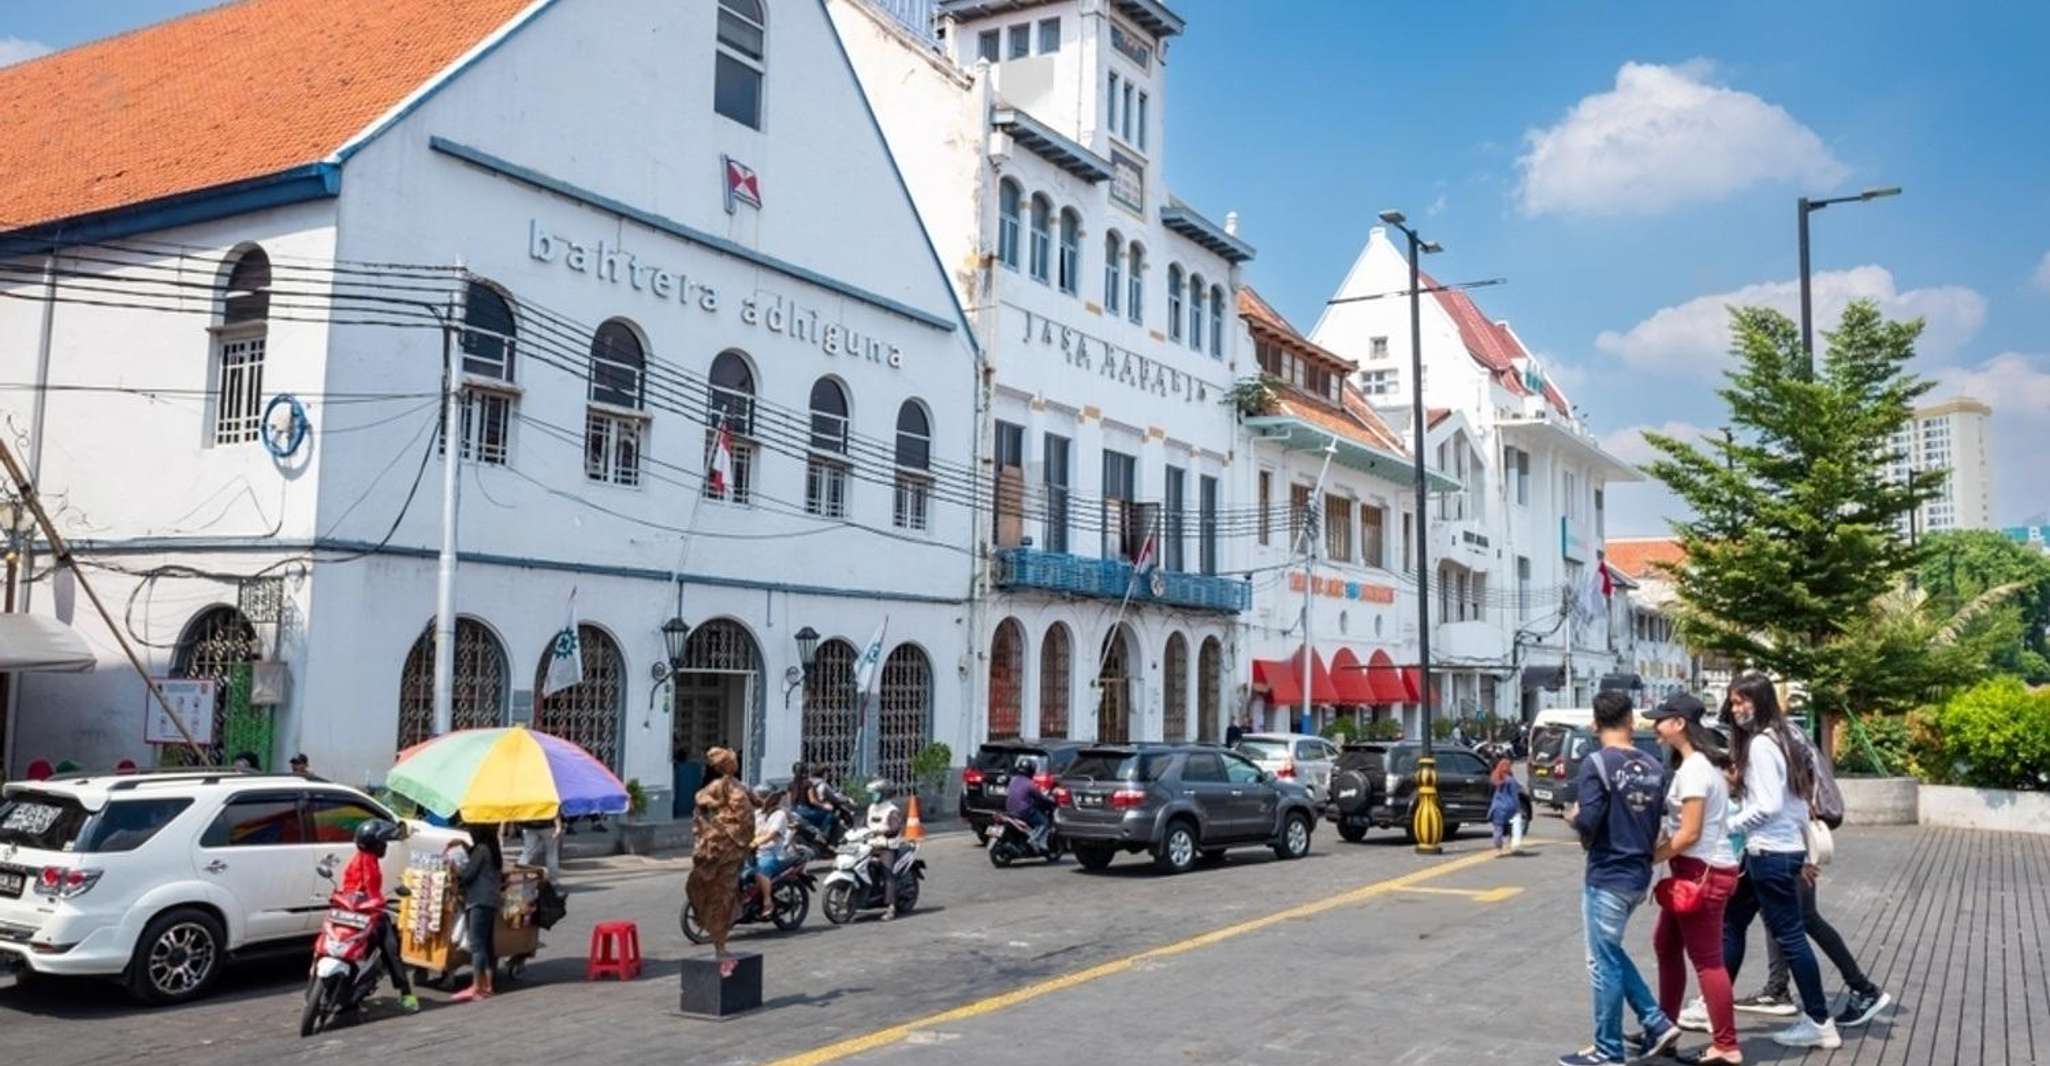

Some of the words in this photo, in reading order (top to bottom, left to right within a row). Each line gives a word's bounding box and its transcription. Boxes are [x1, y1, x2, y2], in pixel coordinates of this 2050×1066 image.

[528, 217, 721, 312] bahtera
[739, 294, 904, 369] adhiguna
[1021, 310, 1088, 364] JASA
